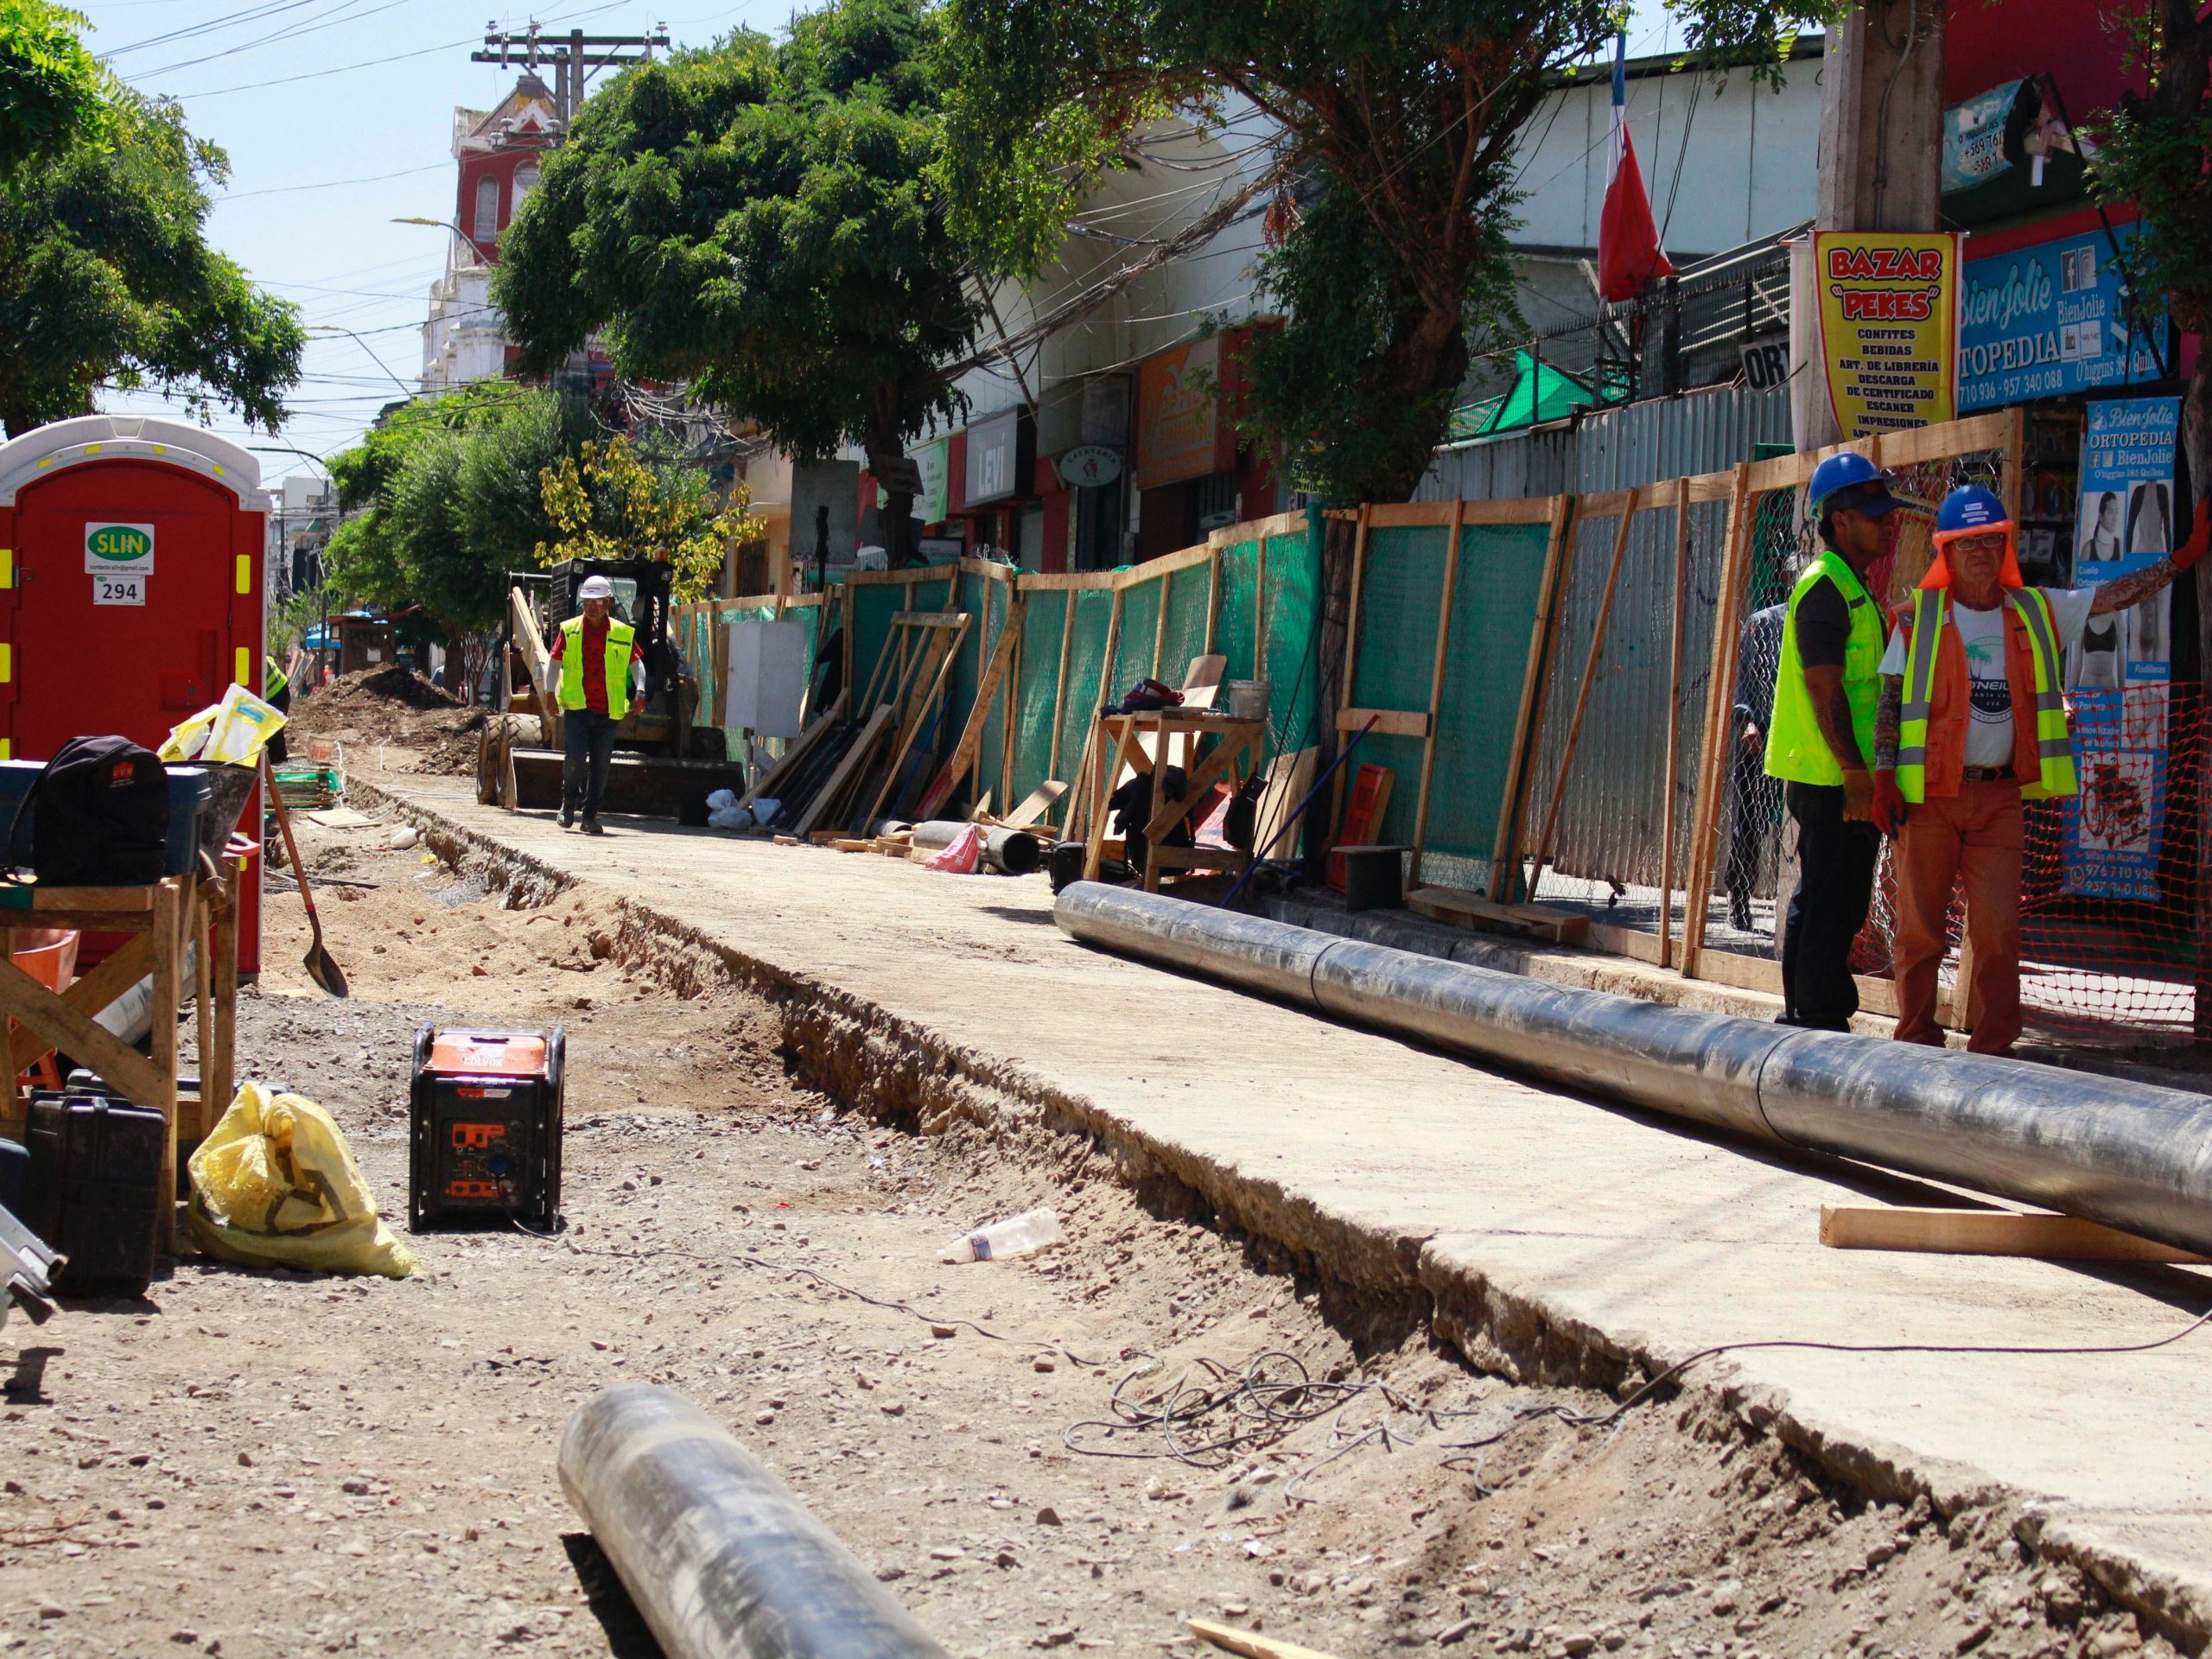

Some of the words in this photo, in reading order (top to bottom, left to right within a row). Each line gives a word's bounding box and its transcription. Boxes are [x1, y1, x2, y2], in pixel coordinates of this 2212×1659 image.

[1829, 247, 1942, 281] BAZAR
[1831, 285, 1940, 321] "PEKES"
[2056, 293, 2106, 324] BienJolie
[1858, 329, 1915, 340] CONFITES
[1862, 346, 1912, 356] BEBIDAS
[1840, 360, 1864, 371] ART.
[1867, 361, 1882, 372] DE
[1885, 359, 1939, 372] LIBRERÍA
[1859, 374, 1916, 385] DESCARGA
[1961, 389, 1977, 404] 710
[1979, 381, 1996, 401] 936
[2004, 377, 2020, 397] 957
[2024, 372, 2043, 393] 340
[2044, 369, 2063, 389] 088
[1847, 386, 1860, 397] DE
[1863, 387, 1934, 399] CERTIFICADO
[1866, 401, 1915, 412] ESCANER
[1858, 415, 1929, 428] IMPRESIONES
[2109, 404, 2173, 429] BienJolie
[2090, 431, 2173, 448] ORTOPEDIA
[2117, 448, 2172, 467] BienJolie
[97, 533, 143, 554] SLIN
[2078, 567, 2099, 576] Cuello
[103, 583, 137, 600] 294
[2087, 864, 2107, 877] 976
